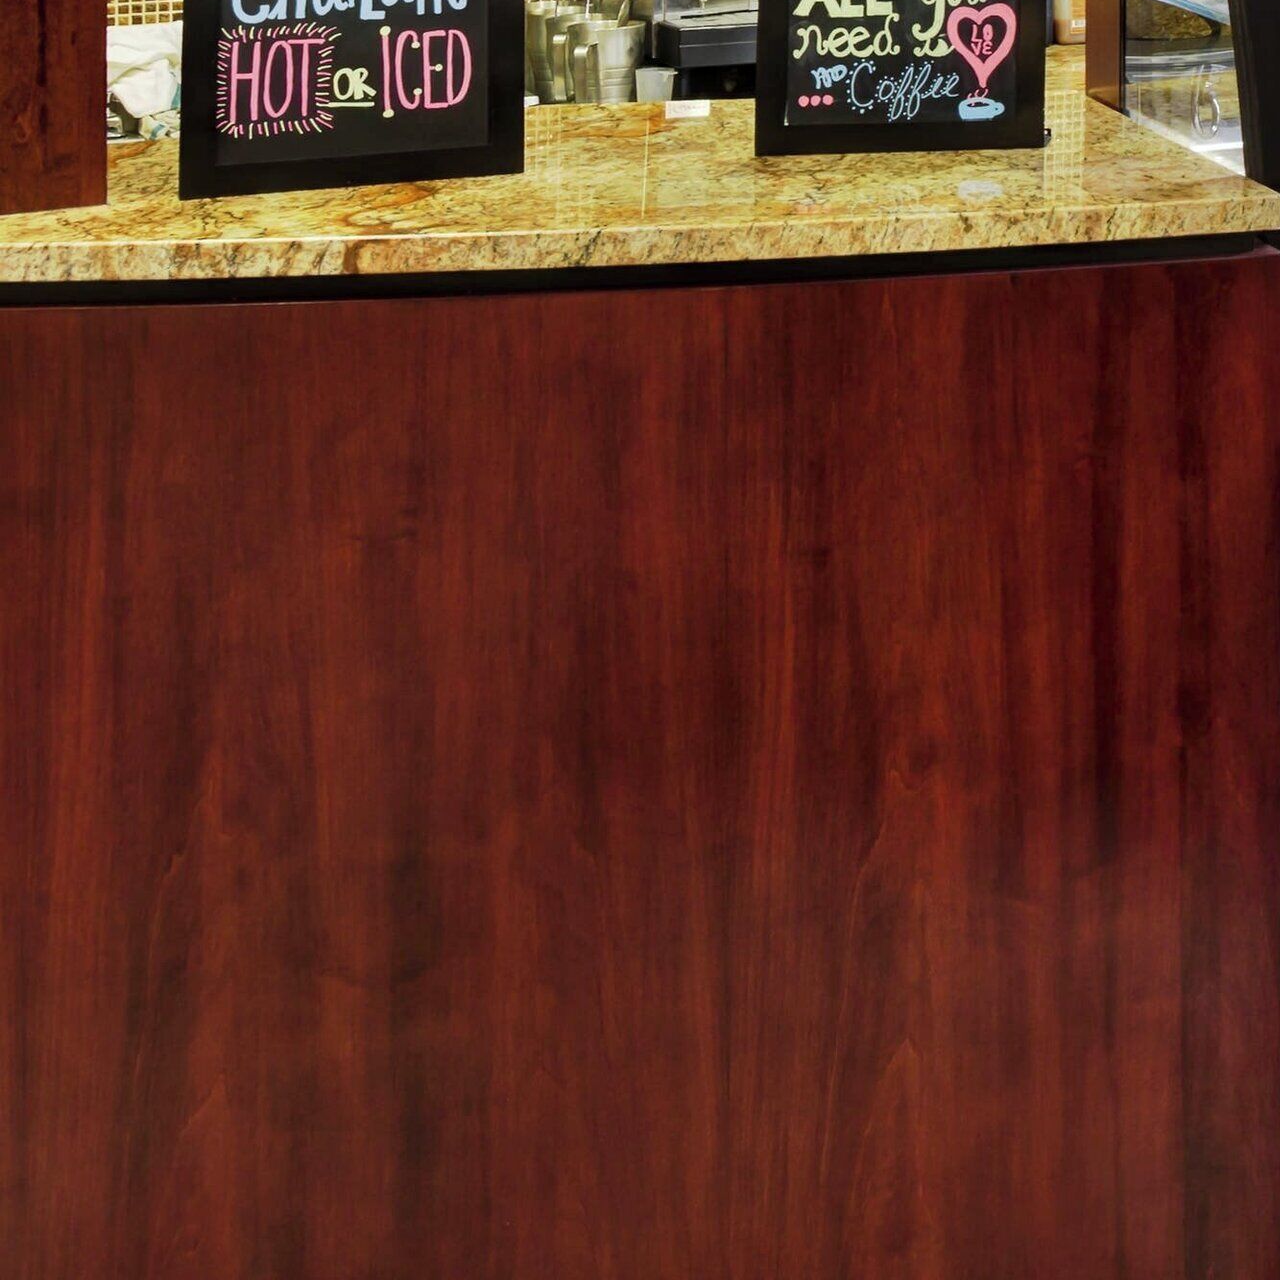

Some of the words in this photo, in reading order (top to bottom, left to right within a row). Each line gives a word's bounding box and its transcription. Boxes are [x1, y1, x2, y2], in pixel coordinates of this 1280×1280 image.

[793, 13, 900, 59] need
[230, 38, 325, 123] HOT
[332, 67, 377, 100] OR
[379, 25, 472, 118] ICED
[850, 62, 960, 121] Coffee
